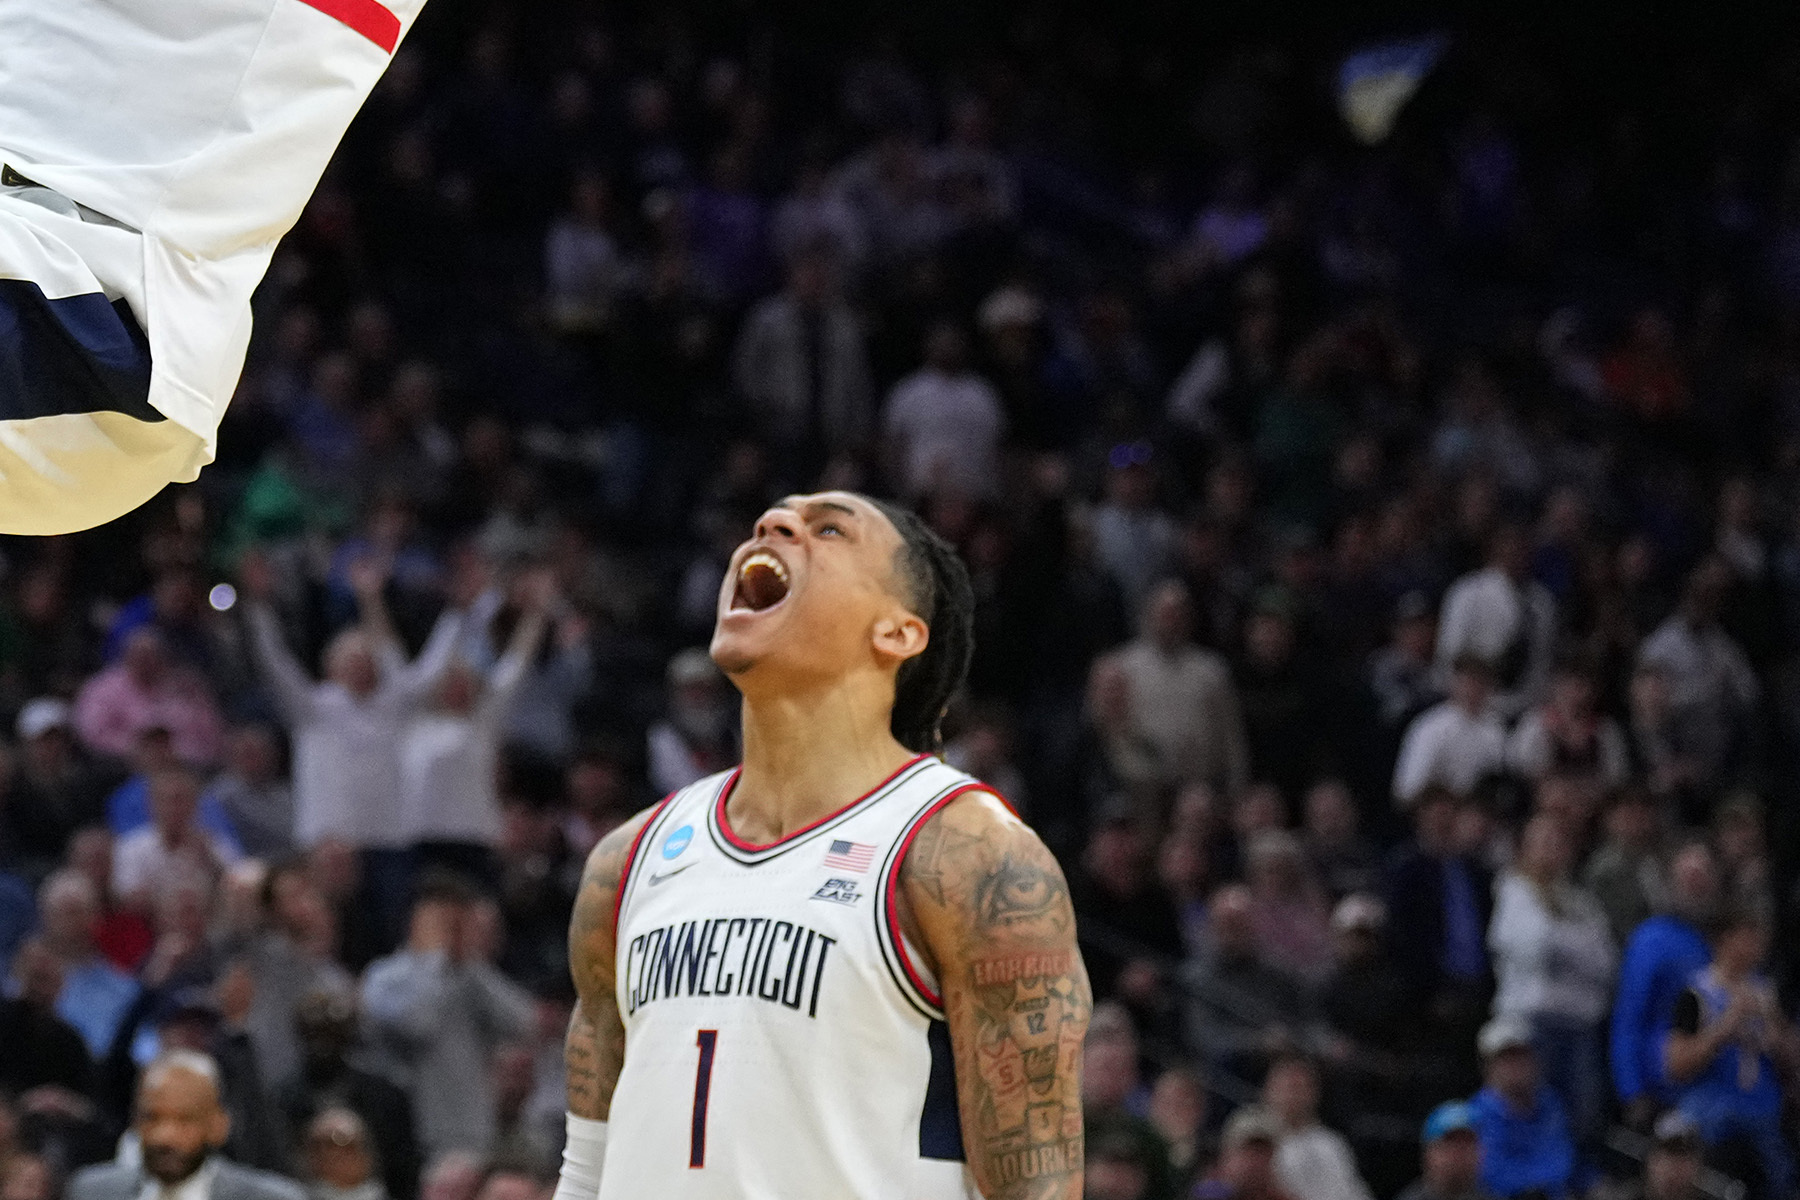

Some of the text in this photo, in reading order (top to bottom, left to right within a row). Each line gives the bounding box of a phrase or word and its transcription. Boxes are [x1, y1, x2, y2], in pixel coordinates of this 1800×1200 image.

[814, 888, 863, 903] EAST
[823, 878, 858, 892] BIG
[626, 918, 837, 1019] CONNECTICUT
[689, 1029, 719, 1169] 1
